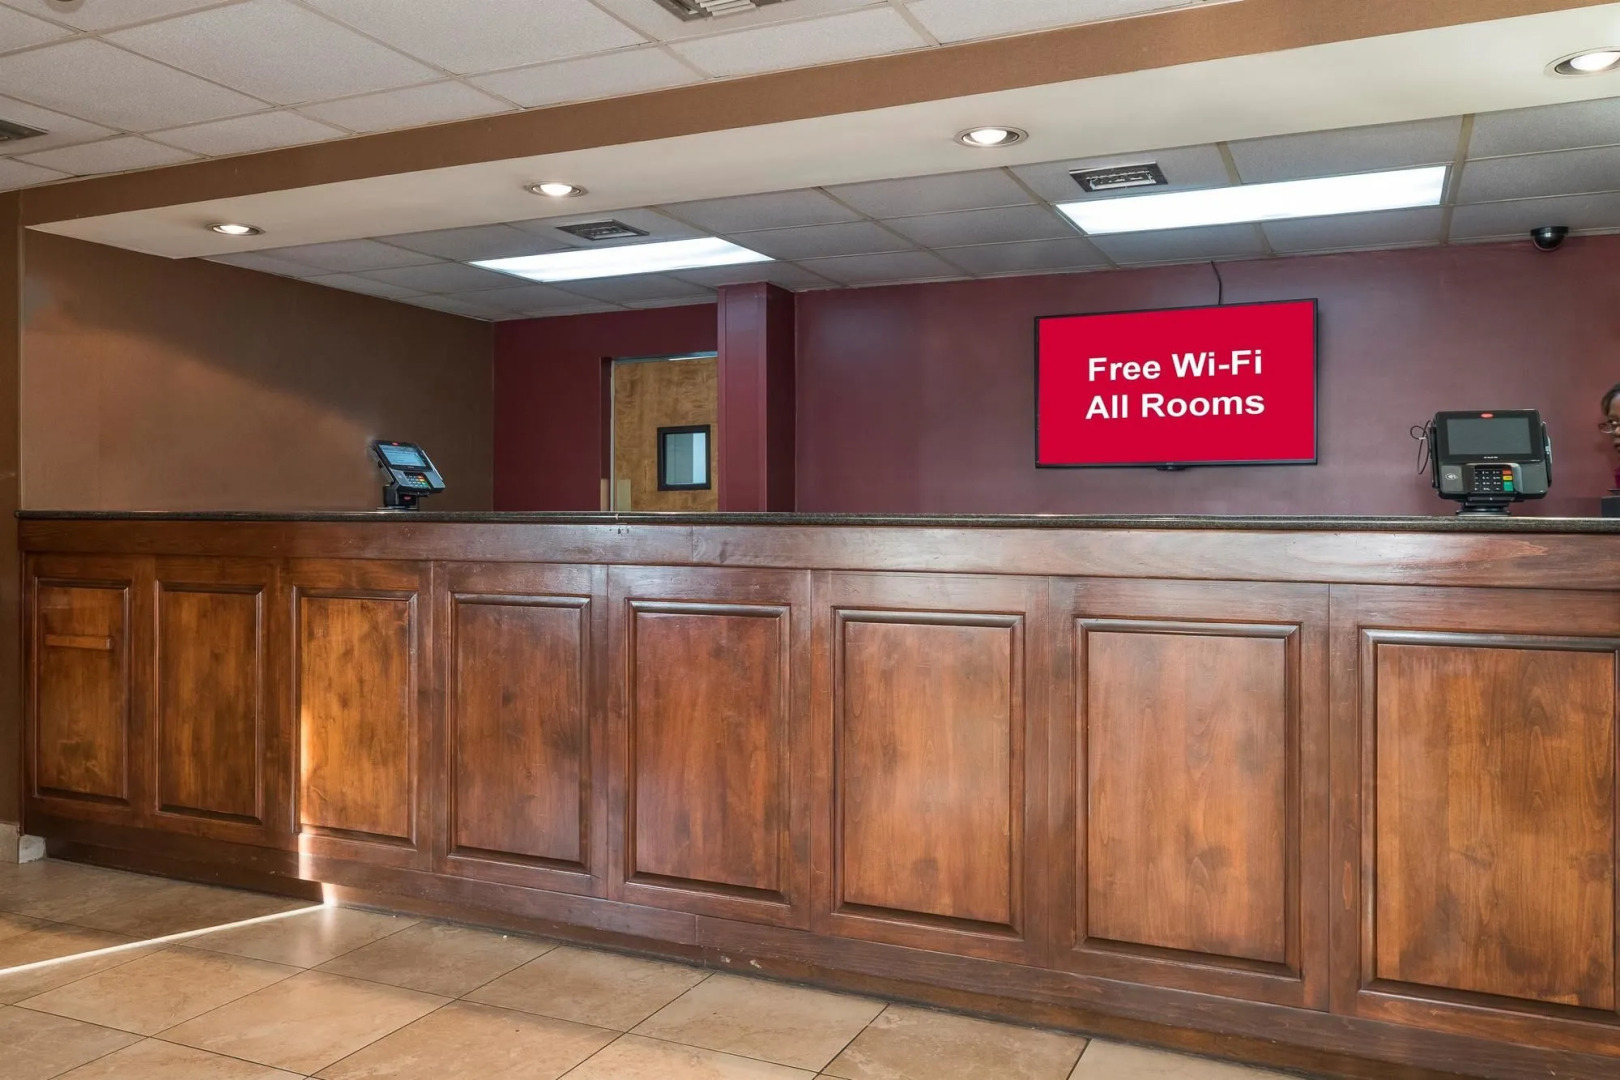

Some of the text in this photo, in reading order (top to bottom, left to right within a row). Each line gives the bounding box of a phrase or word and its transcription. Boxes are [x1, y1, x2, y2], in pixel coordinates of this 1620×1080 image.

[1088, 349, 1262, 382] Free Wi-Fi
[1085, 393, 1265, 420] All Rooms
